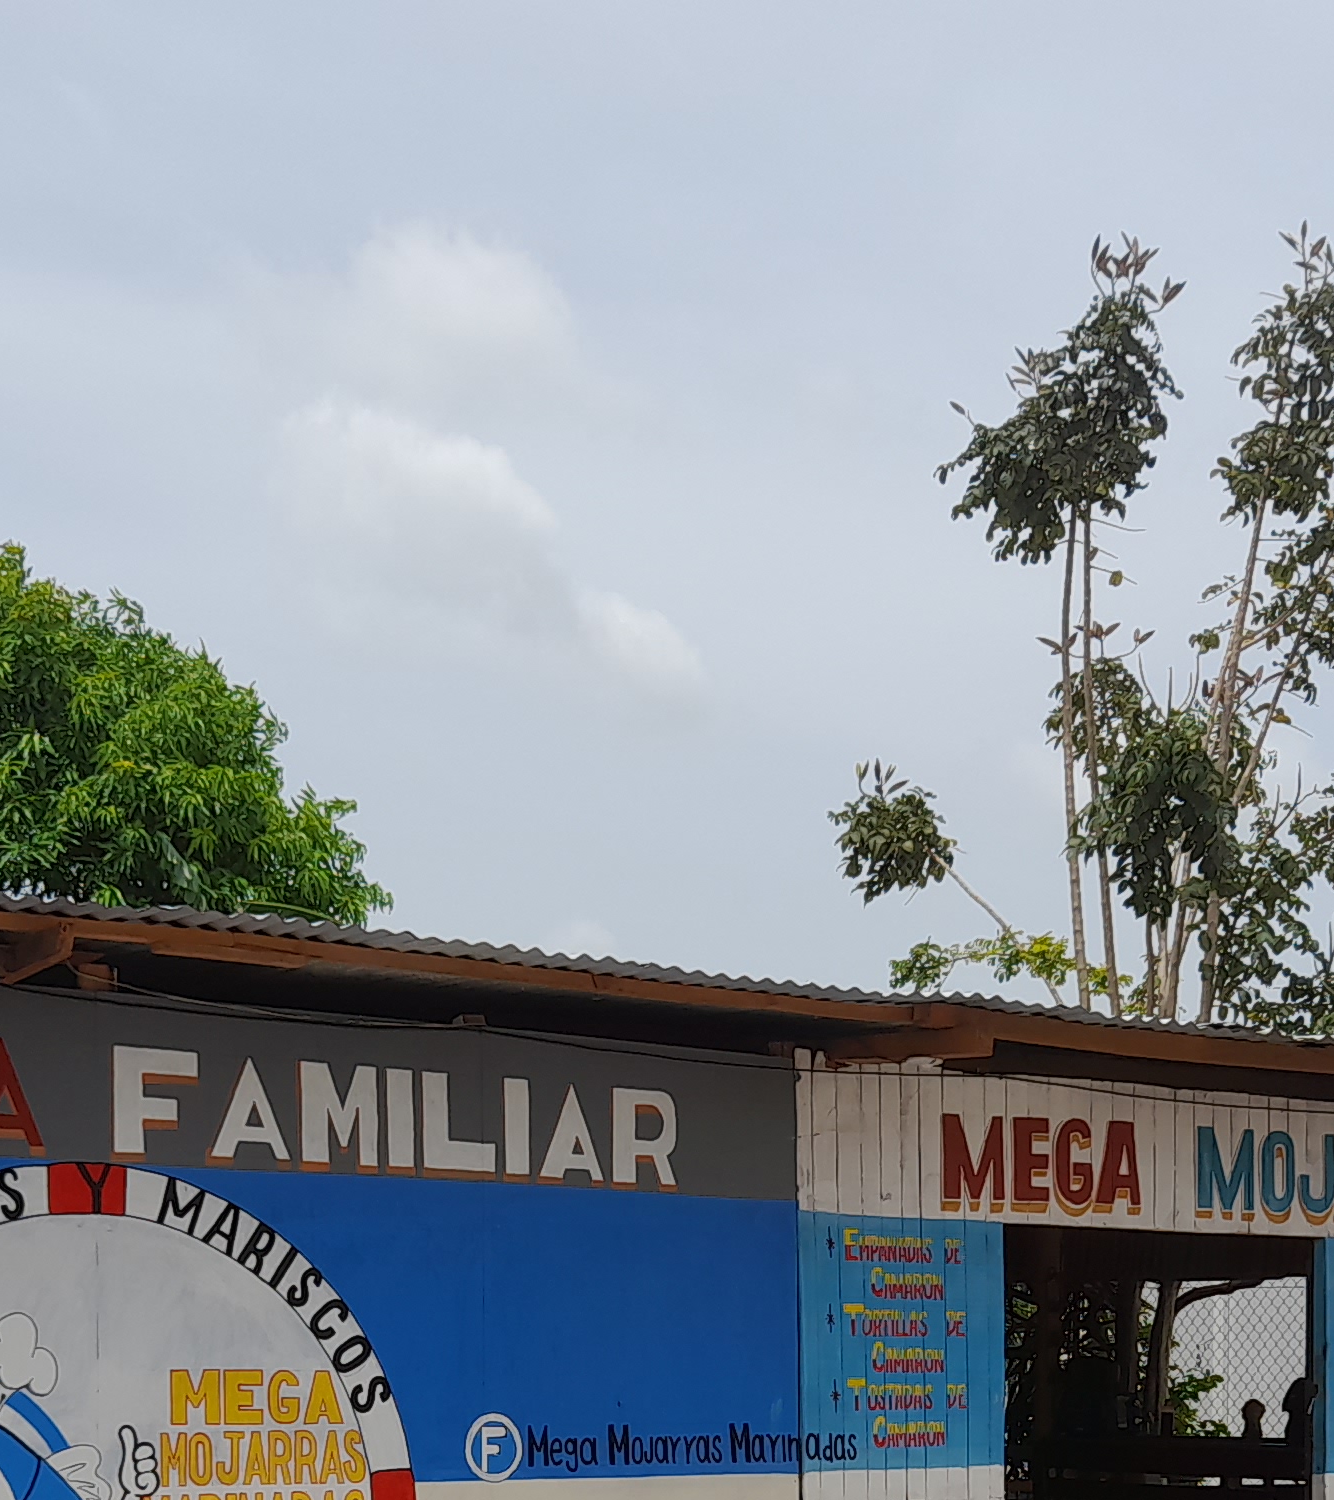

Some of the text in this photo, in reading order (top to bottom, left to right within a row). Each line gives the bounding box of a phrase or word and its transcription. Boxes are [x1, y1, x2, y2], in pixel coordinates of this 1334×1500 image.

[111, 1044, 677, 1193] FAMILIAR
[939, 1113, 1142, 1217] MEGA
[945, 1237, 964, 1264] DE
[79, 1163, 113, 1214] Y
[157, 1176, 392, 1414] MARISCOS
[946, 1311, 966, 1337] DE
[170, 1369, 344, 1426] MEGA
[947, 1384, 967, 1409] DE
[159, 1429, 366, 1488] MOJARRAS
[527, 1424, 599, 1472] Mega
[607, 1423, 723, 1466] Mojarras
[729, 1421, 859, 1465] Marinadas
